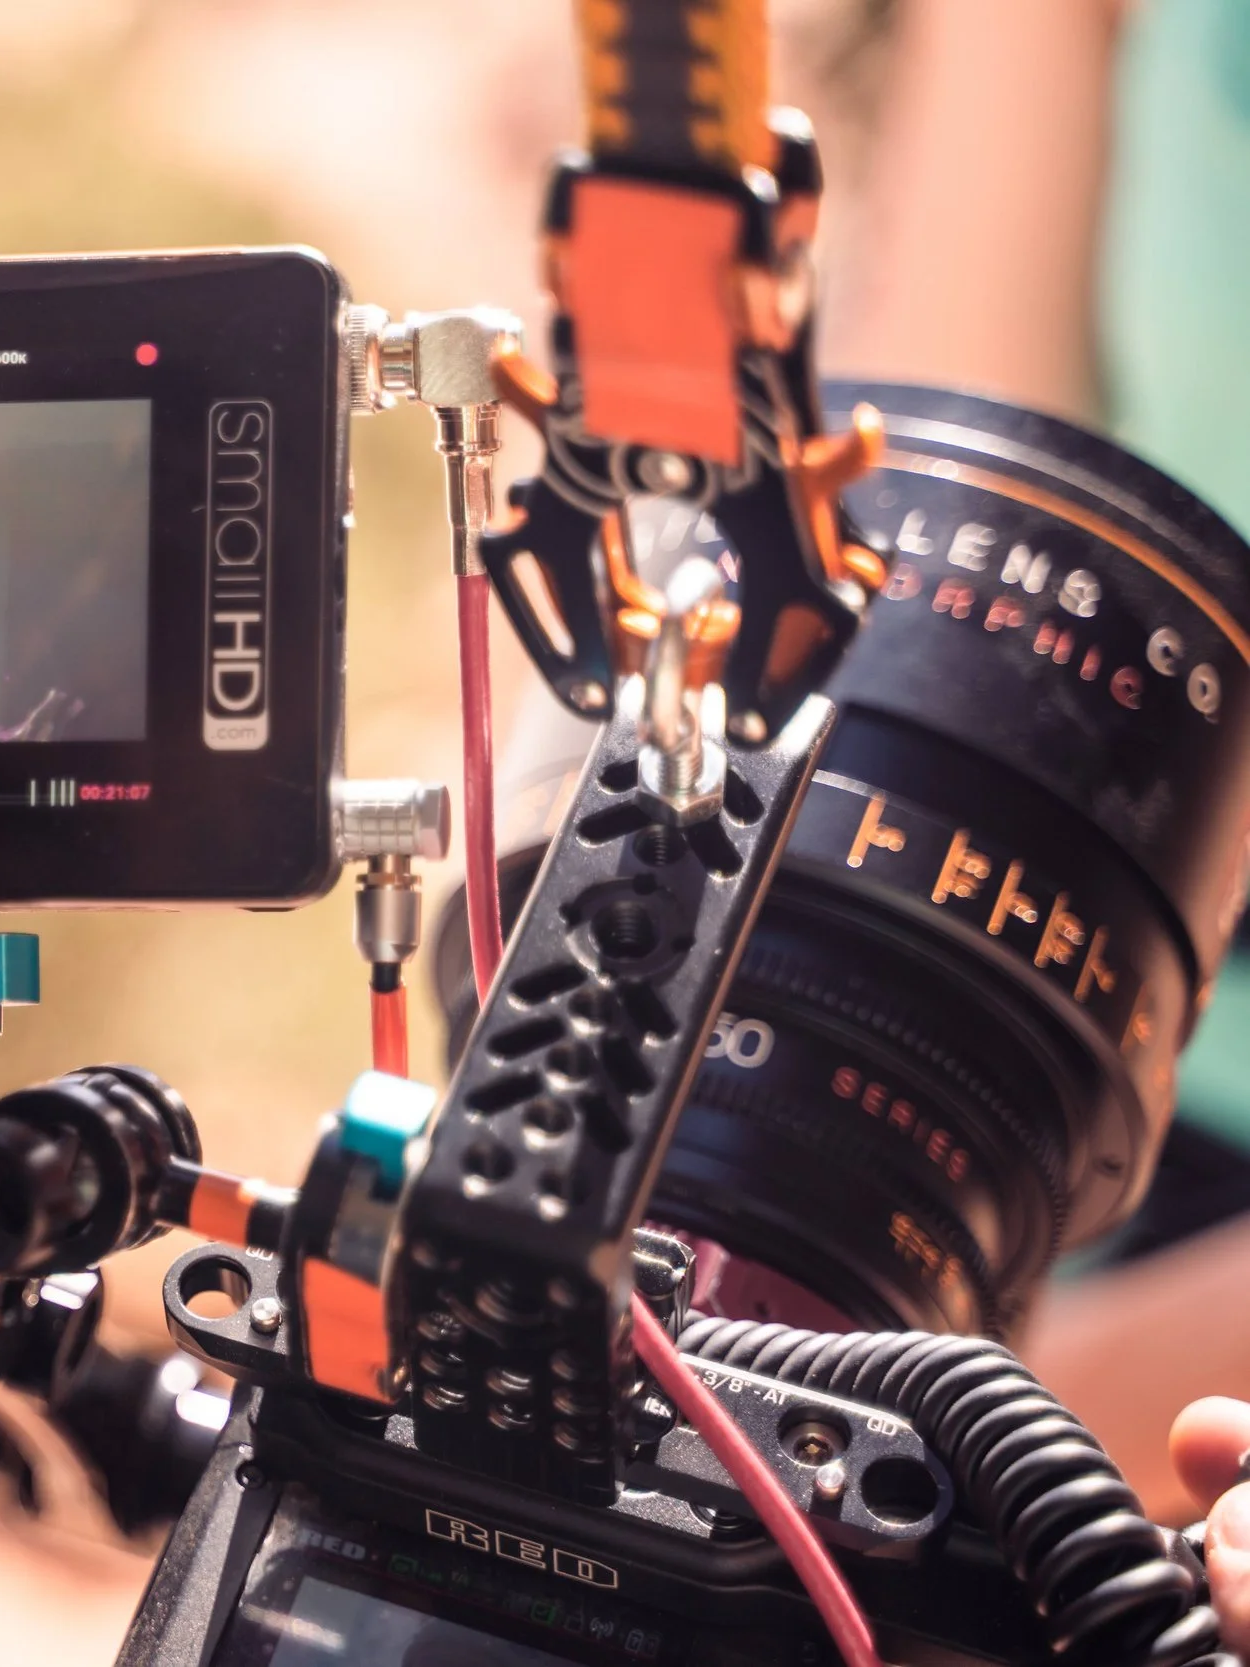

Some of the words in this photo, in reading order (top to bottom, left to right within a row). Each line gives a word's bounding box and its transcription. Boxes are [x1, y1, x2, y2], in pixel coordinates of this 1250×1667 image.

[896, 507, 1102, 617] LENS
[81, 784, 150, 801] 00:21:07
[867, 1415, 899, 1437] QD
[426, 1508, 619, 1589] RED
